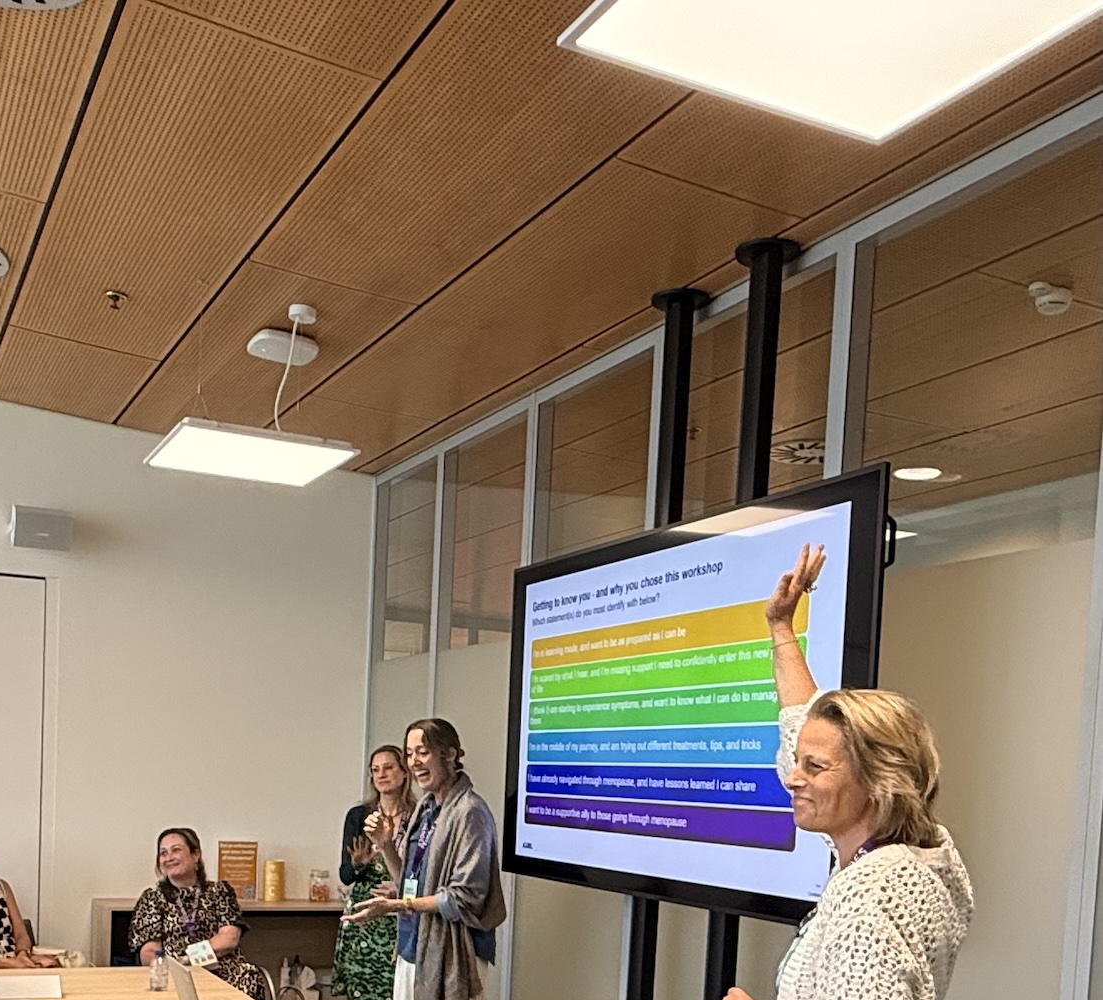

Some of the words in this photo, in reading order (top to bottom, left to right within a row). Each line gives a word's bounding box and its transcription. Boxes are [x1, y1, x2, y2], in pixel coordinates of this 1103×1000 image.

[533, 600, 553, 612] Getting
[554, 598, 560, 607] to
[561, 595, 578, 606] know
[579, 592, 591, 605] you
[596, 586, 608, 598] and
[610, 584, 624, 596] why
[626, 582, 638, 595] you
[641, 575, 663, 588] chose
[665, 570, 680, 583] this
[682, 562, 723, 580] workshop
[532, 618, 546, 626] Which
[576, 610, 582, 618] do
[583, 609, 592, 618] you
[593, 605, 606, 614] most
[606, 600, 624, 612] identify
[627, 598, 638, 608] with
[639, 592, 660, 606] below?
[580, 642, 590, 652] and
[610, 638, 617, 647] be
[626, 632, 652, 648] prepared
[664, 629, 676, 639] can
[677, 627, 686, 637] be
[632, 662, 654, 673] support
[658, 658, 674, 669] need
[674, 658, 681, 668] to
[682, 653, 717, 667] confidently
[719, 652, 736, 663] enter
[738, 650, 752, 660] this
[753, 649, 769, 659] new
[642, 698, 653, 708] and
[670, 696, 676, 706] to
[677, 695, 694, 706] know
[695, 694, 711, 704] what
[717, 694, 730, 703] can
[731, 692, 741, 703] do
[742, 691, 750, 702] to
[751, 691, 777, 703] manag
[565, 742, 571, 751] of
[600, 741, 610, 751] and
[620, 741, 636, 753] trying
[637, 741, 647, 751] out
[647, 740, 672, 751] different
[673, 740, 709, 752] treatments,
[710, 739, 725, 752] tips,
[726, 739, 740, 750] and
[741, 739, 762, 750] tricks
[559, 775, 582, 786] navigated
[582, 775, 602, 787] through
[603, 777, 636, 788] menopause,
[637, 777, 648, 788] and
[649, 777, 664, 788] have
[665, 777, 689, 789] lessons
[690, 778, 715, 790] learned
[720, 781, 734, 791] can
[735, 779, 756, 792] share
[545, 806, 551, 815] be
[556, 808, 580, 819] supportive
[581, 809, 589, 821] ally
[590, 810, 596, 820] to
[597, 810, 611, 820] those
[612, 812, 628, 824] going
[628, 813, 650, 826] through
[650, 816, 687, 828] menopause
